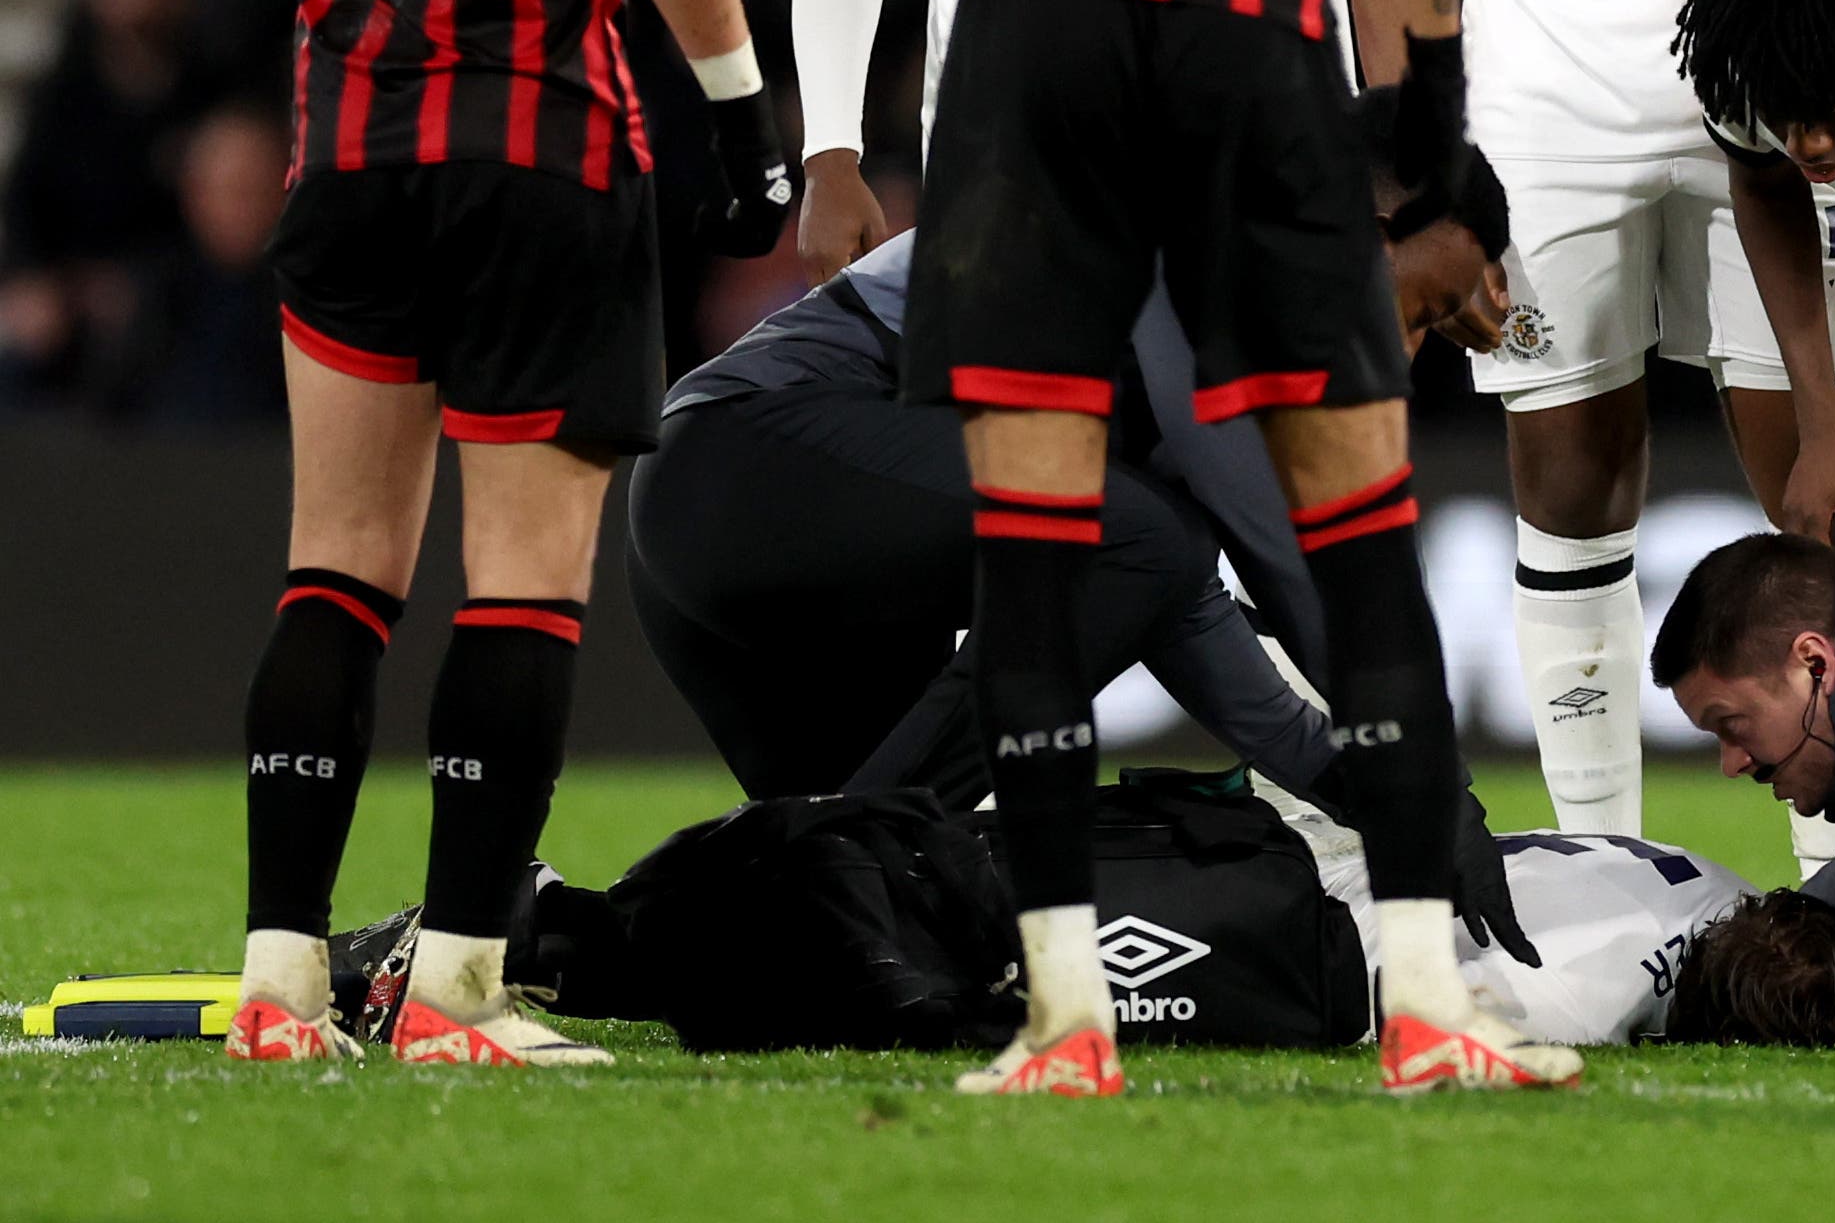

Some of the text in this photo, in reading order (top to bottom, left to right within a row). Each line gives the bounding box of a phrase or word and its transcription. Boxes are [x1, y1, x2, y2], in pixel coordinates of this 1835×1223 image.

[1552, 707, 1607, 722] umbro
[997, 722, 1093, 759] AFCB
[250, 753, 336, 779] AFCB
